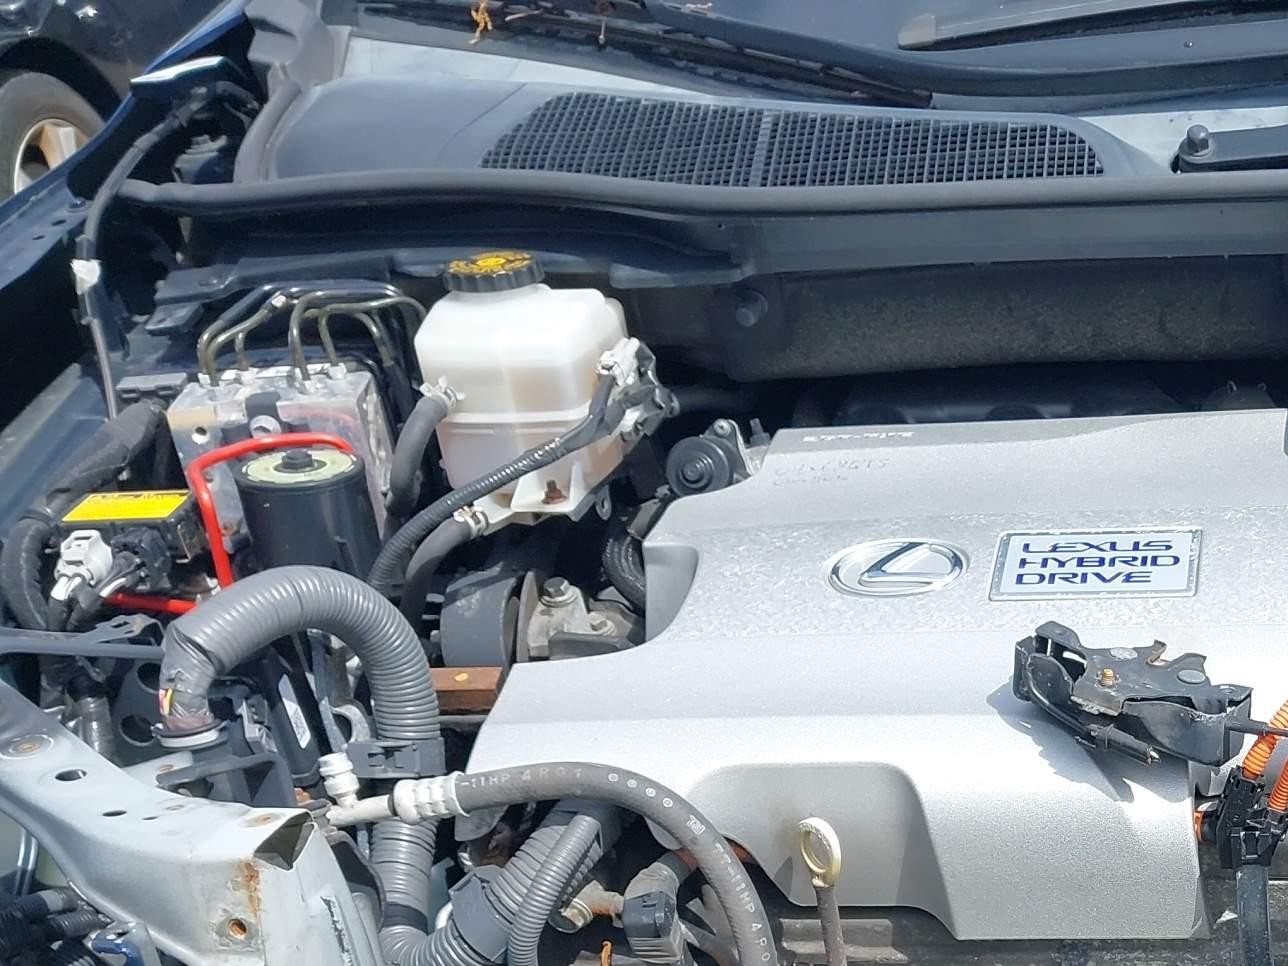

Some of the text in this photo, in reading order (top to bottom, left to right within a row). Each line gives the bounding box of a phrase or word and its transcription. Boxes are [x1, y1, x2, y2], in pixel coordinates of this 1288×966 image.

[1022, 540, 1173, 553] LEXUS
[1018, 555, 1181, 569] HYBRID
[1015, 571, 1152, 585] DRIVE
